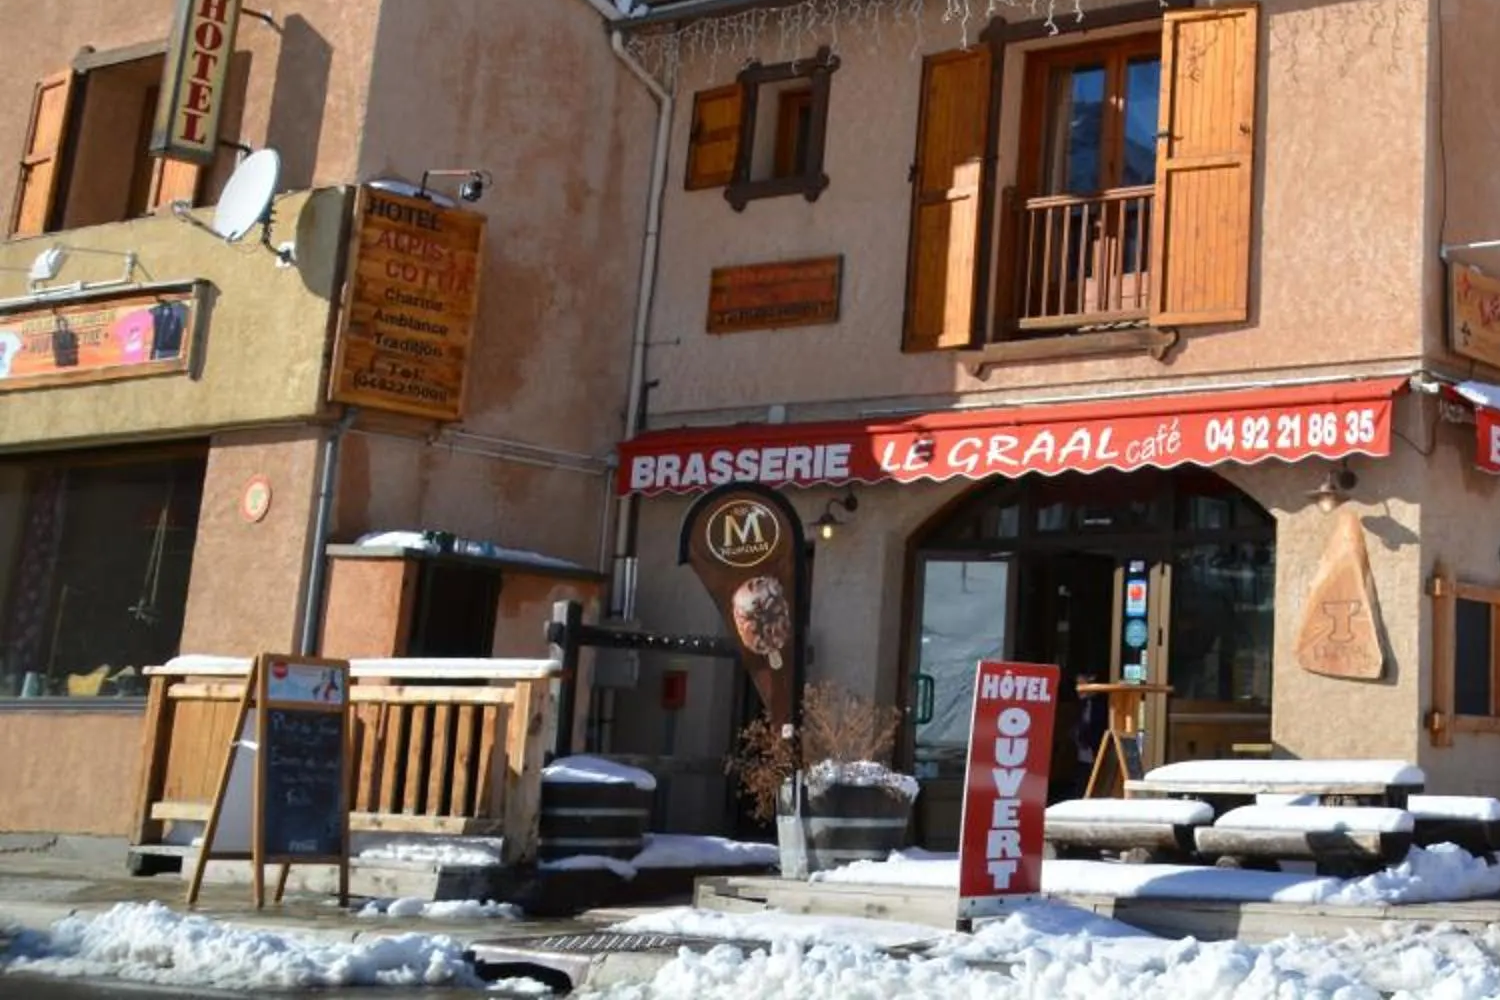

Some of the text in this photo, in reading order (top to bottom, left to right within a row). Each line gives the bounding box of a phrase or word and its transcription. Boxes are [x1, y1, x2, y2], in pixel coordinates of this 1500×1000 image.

[366, 200, 443, 232] HOTEL
[372, 307, 448, 337] Ambiance
[631, 408, 1374, 489] BRASSERIE LE GRAAL café 04 92 21 86 35
[981, 669, 1051, 701] HÔTEL
[986, 707, 1031, 889] OUVERT
